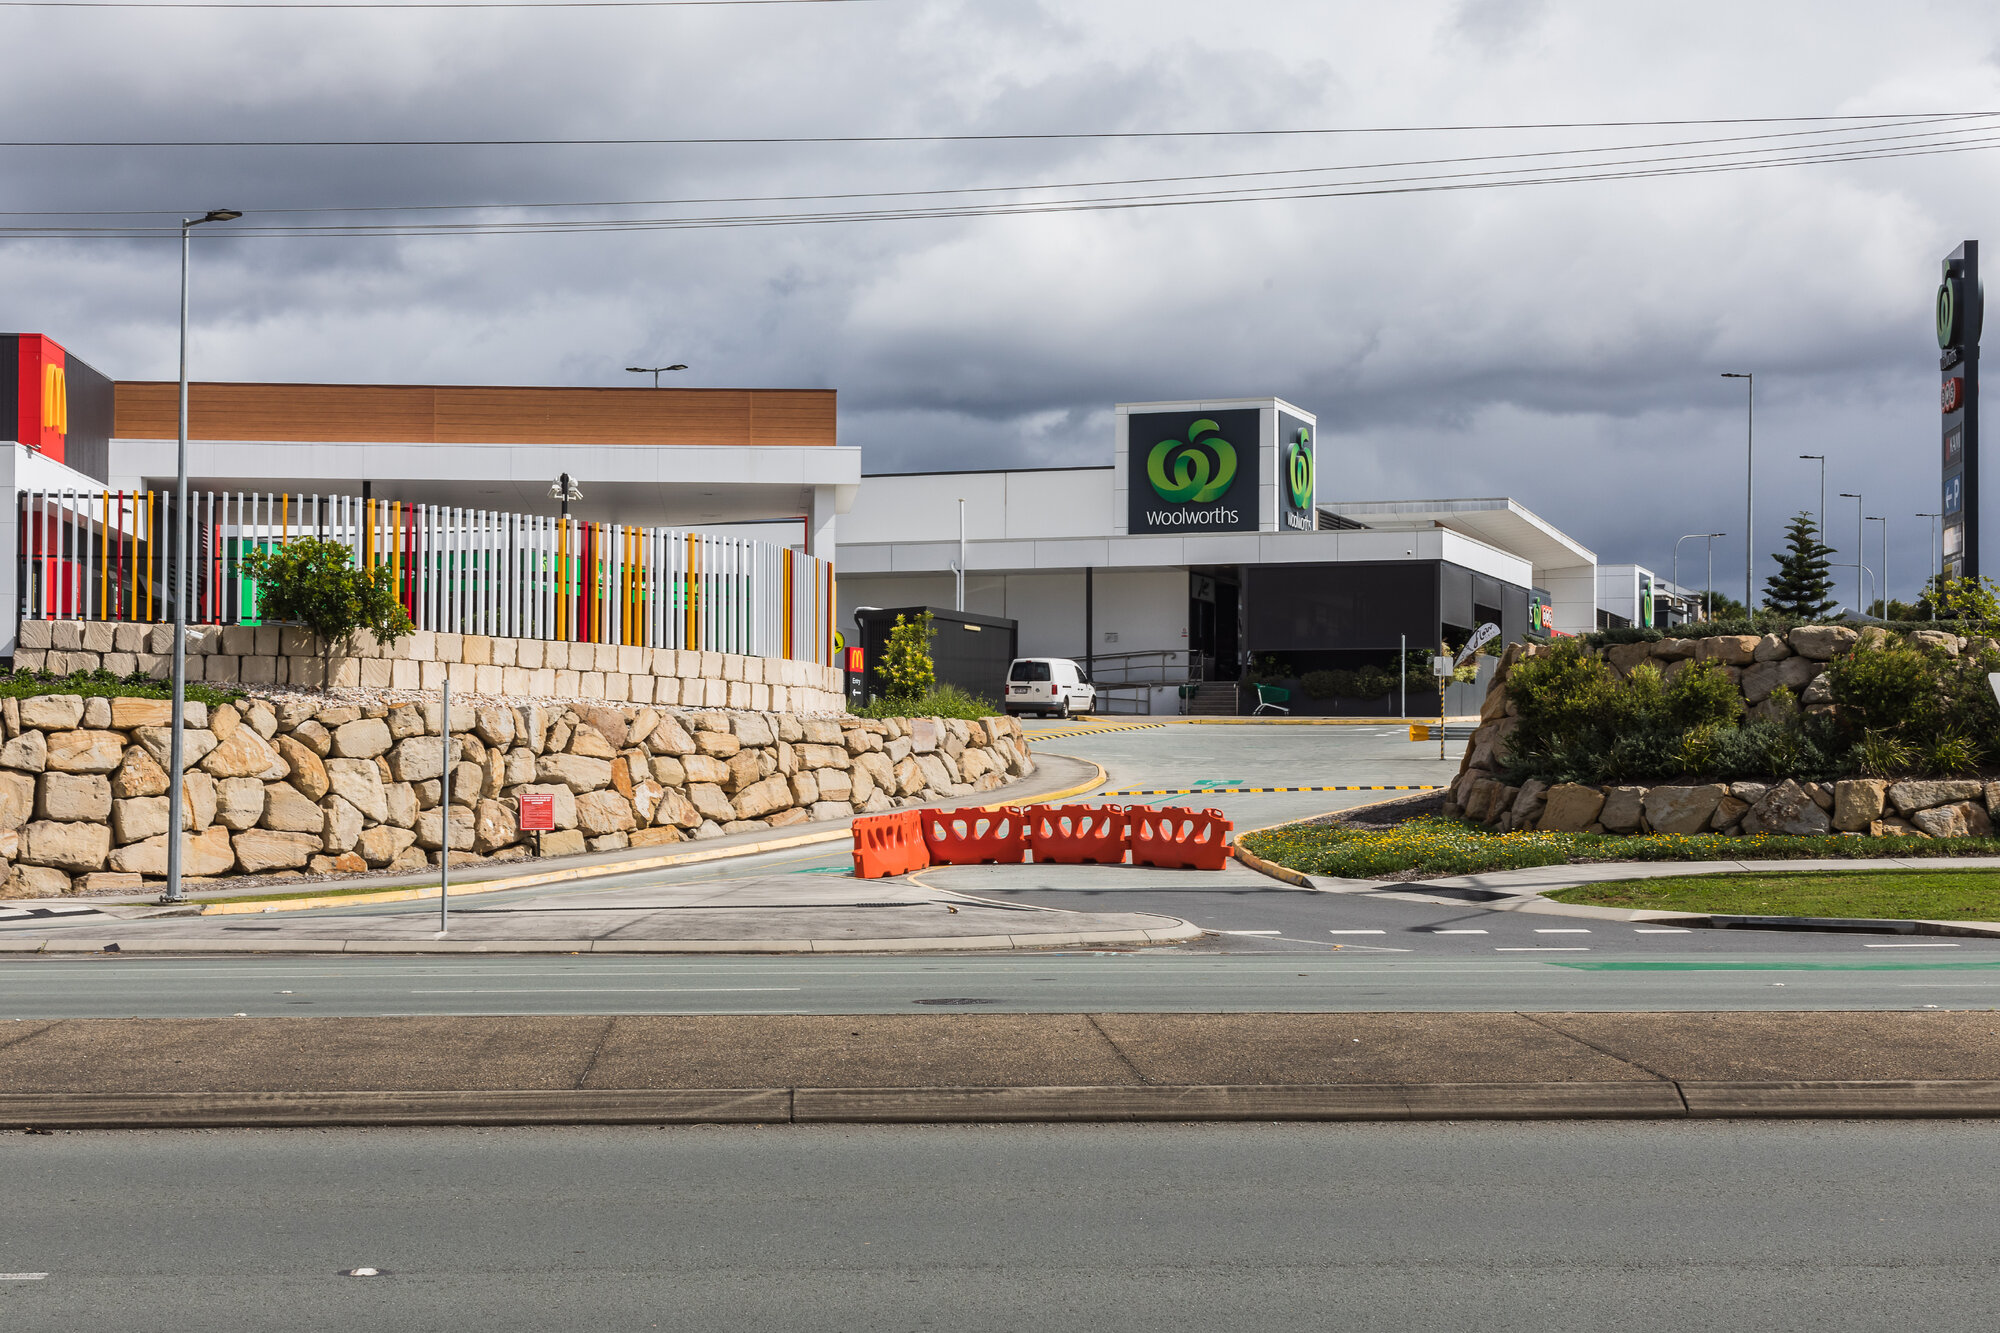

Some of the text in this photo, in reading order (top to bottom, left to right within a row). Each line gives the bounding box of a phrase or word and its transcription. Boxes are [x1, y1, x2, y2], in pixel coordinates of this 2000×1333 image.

[44, 364, 67, 434] M
[1953, 478, 1960, 508] P
[851, 649, 863, 670] M
